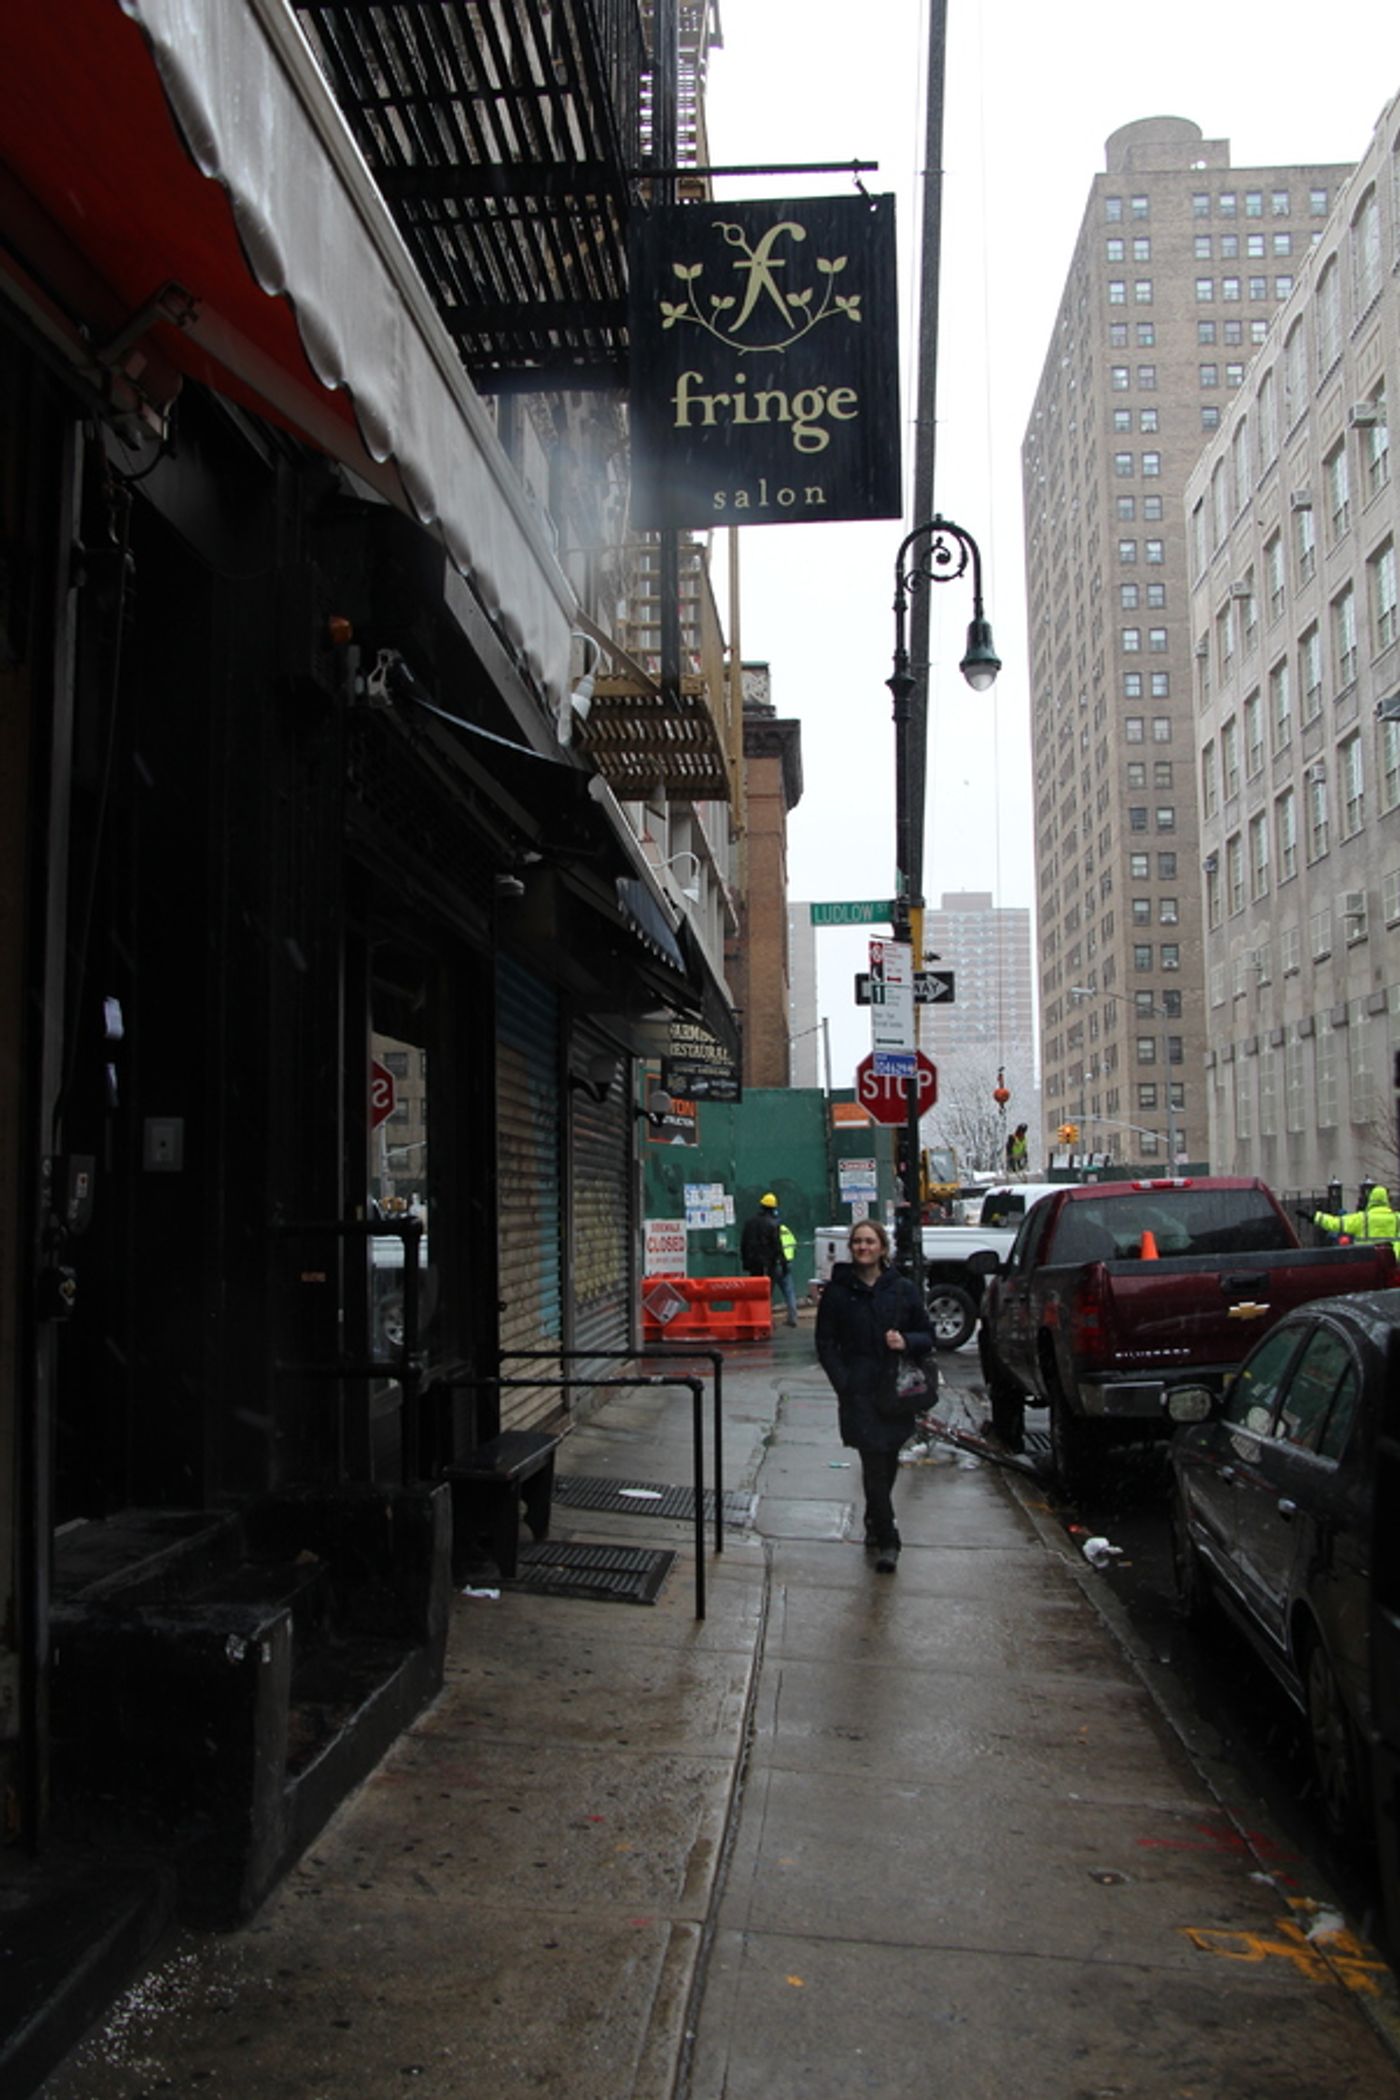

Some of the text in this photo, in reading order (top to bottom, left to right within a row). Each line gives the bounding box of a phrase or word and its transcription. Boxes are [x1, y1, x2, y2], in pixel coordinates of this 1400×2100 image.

[671, 371, 859, 453] fringe
[713, 479, 826, 509] salon
[814, 903, 891, 923] LUDLOW ST
[646, 1236, 685, 1254] CLOSED
